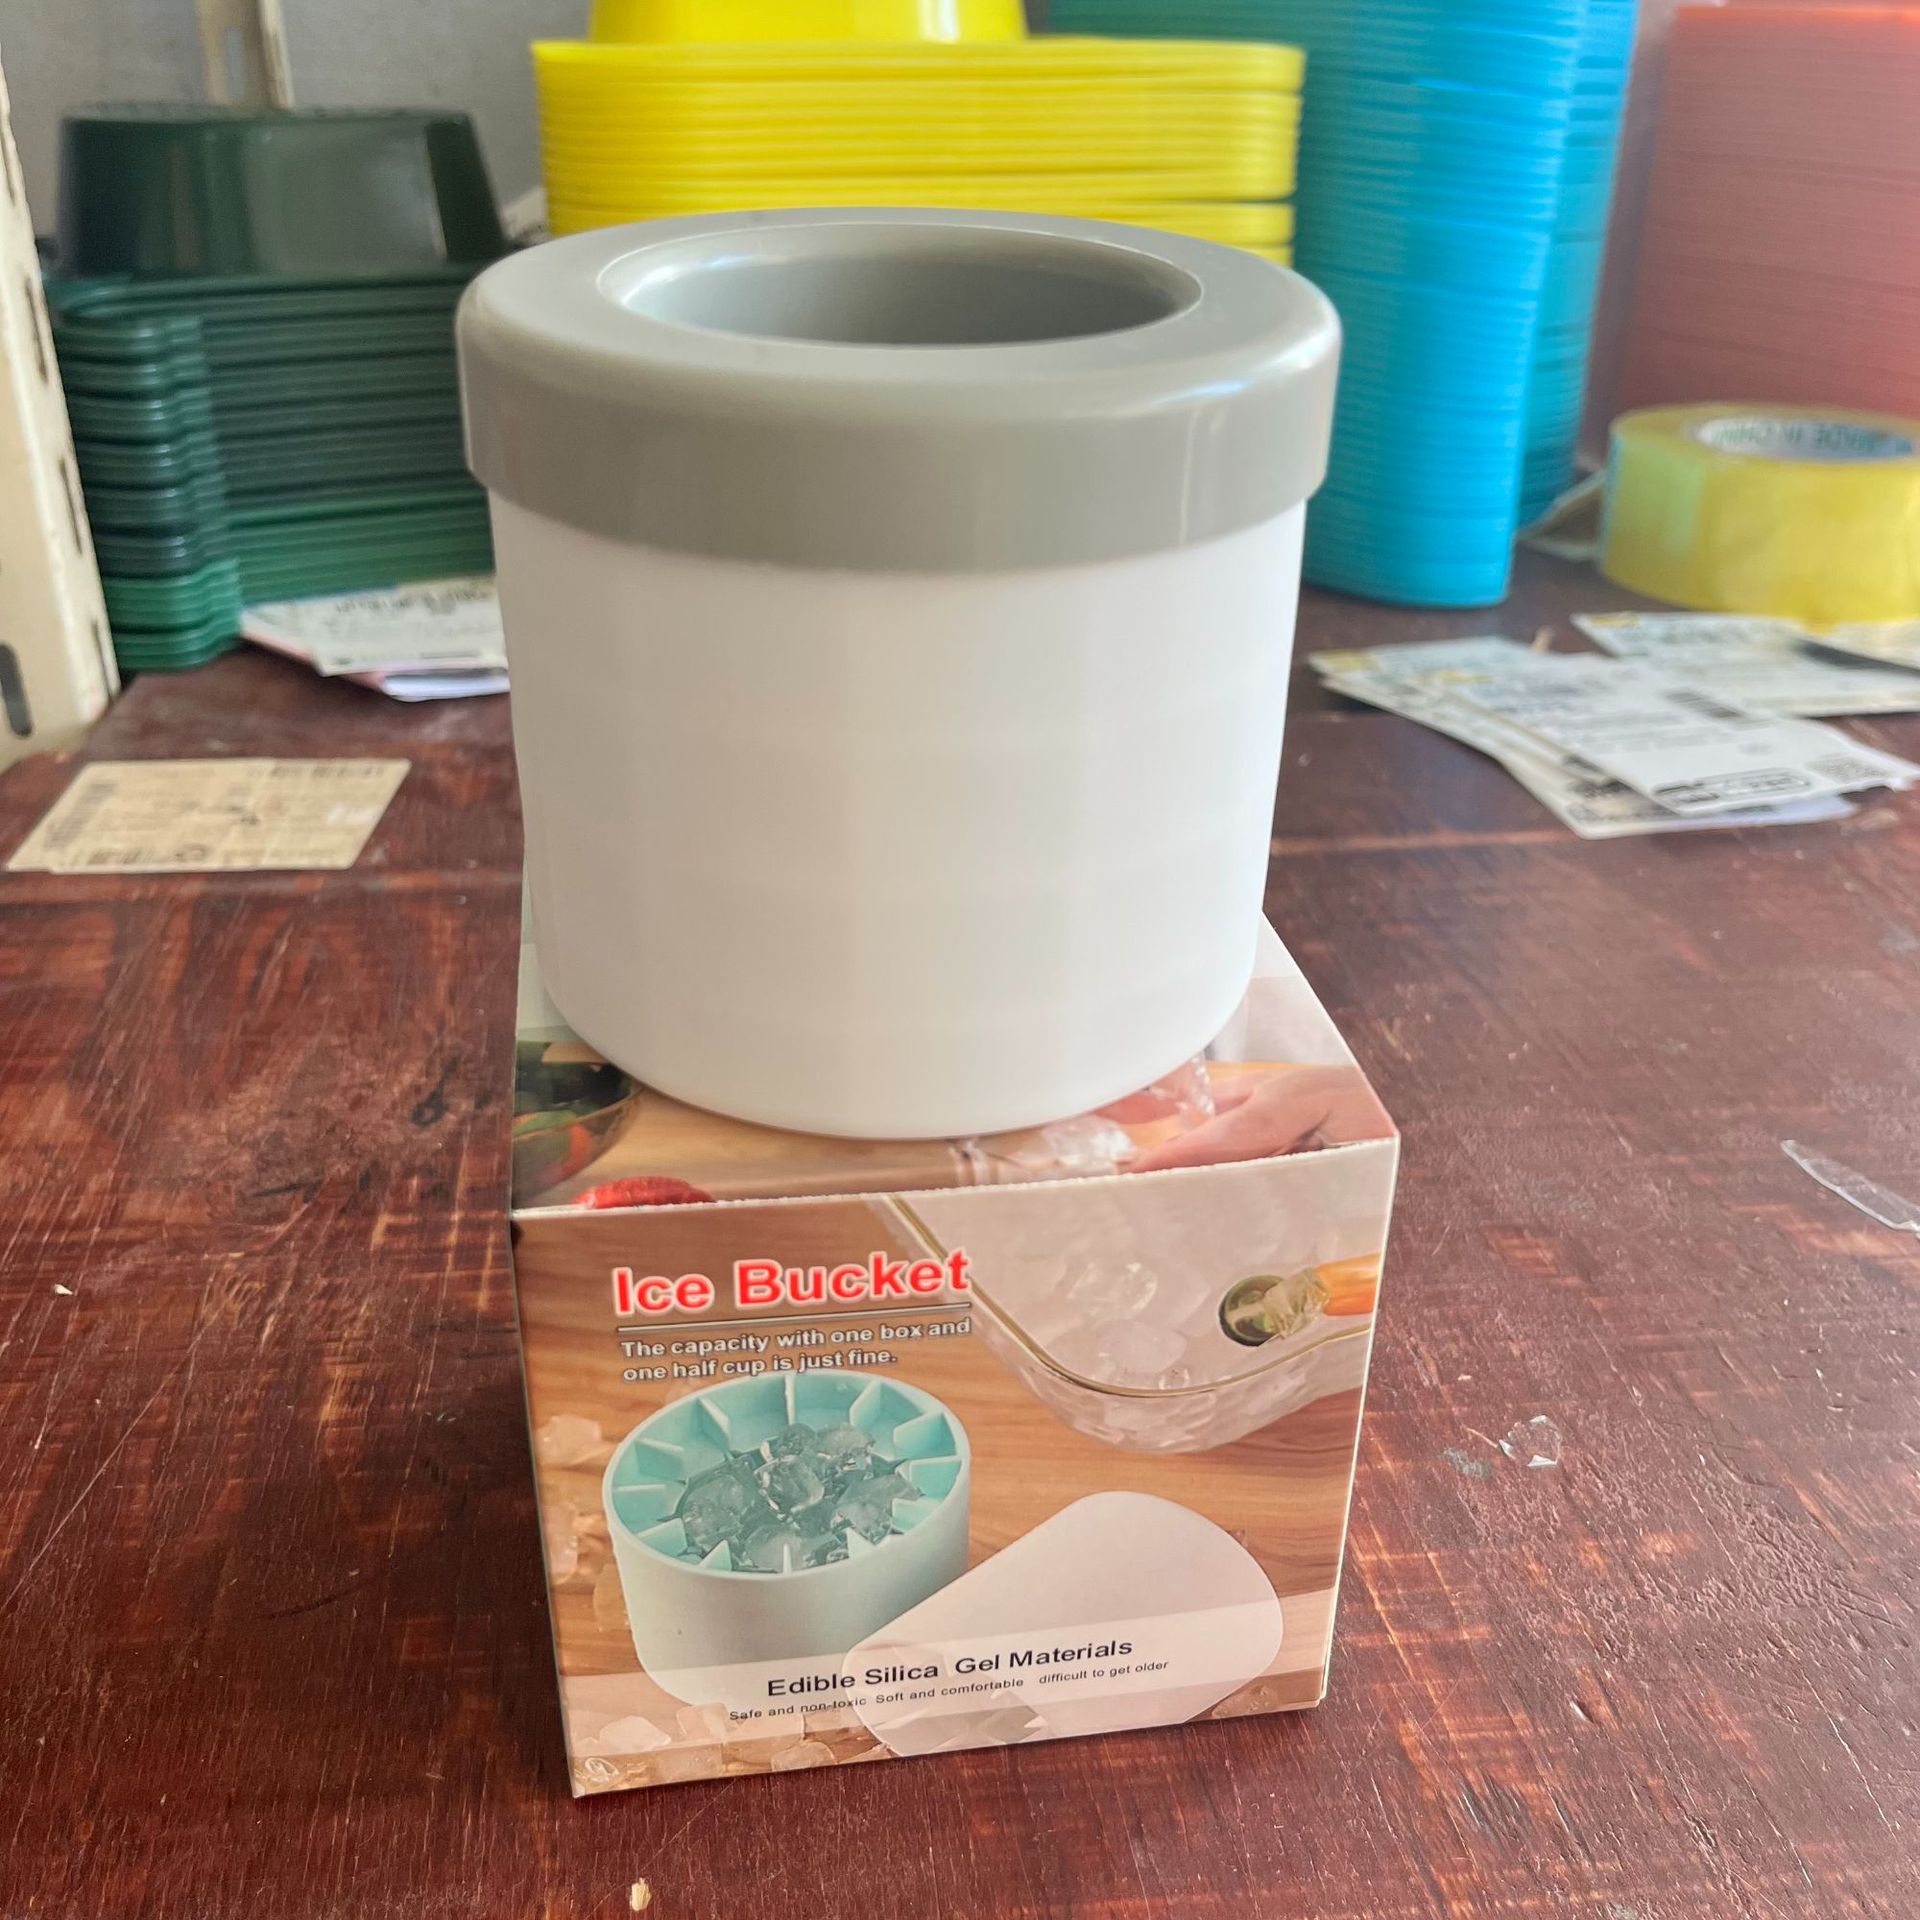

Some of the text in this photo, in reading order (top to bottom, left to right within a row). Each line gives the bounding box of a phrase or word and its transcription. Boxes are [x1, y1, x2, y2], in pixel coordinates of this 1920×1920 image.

[613, 1248, 972, 1317] Ice Bucket
[620, 1316, 972, 1358] The capacity with one box and
[623, 1349, 898, 1381] one half cup is just fine.
[729, 1660, 1170, 1721] Safe and non-toxic Soft and comfortable difficult to get older
[767, 1640, 1133, 1697] Edible Silica Gel Materials
